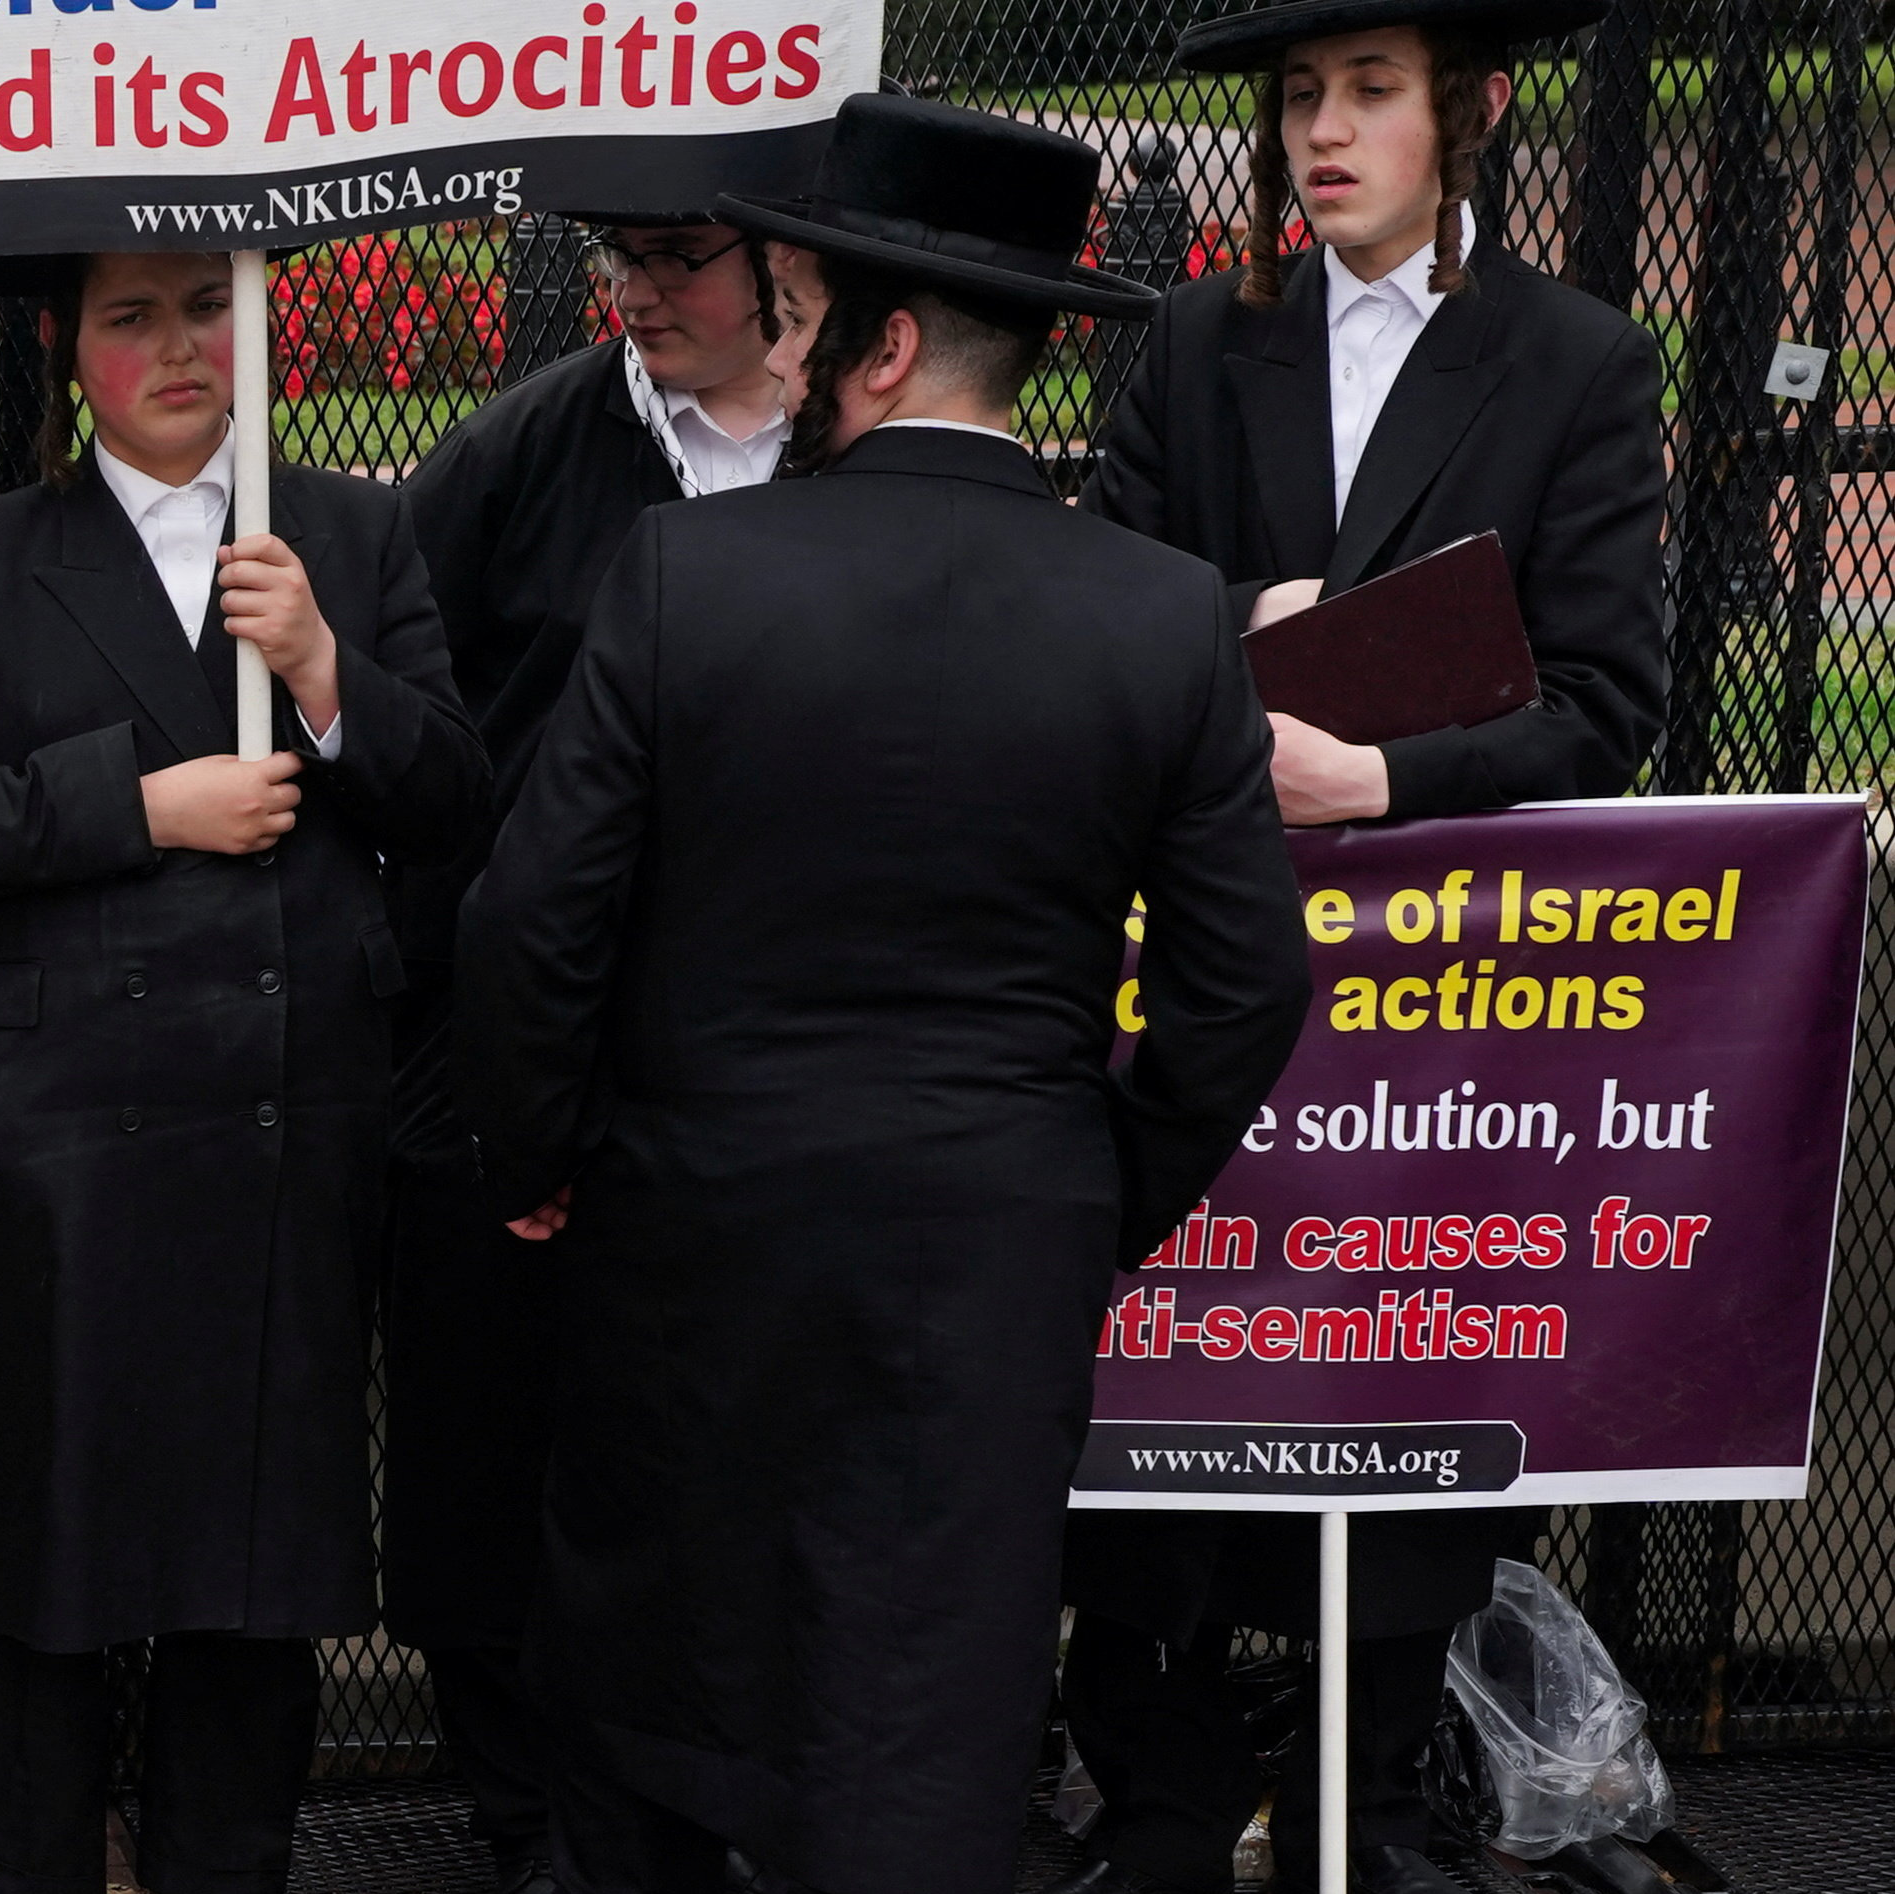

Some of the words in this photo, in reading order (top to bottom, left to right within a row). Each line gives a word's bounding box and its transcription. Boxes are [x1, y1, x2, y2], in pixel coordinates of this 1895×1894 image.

[94, 42, 228, 150] its
[263, 2, 823, 144] Atrocities
[126, 167, 524, 235] www.NKUSA.org
[1385, 870, 1474, 944] of
[1499, 869, 1742, 944] Israel
[1330, 960, 1645, 1032] actions
[1296, 1080, 1577, 1164] solution,
[1597, 1078, 1714, 1152] but
[1283, 1211, 1567, 1272] causes
[1591, 1196, 1711, 1270] for
[1128, 1439, 1461, 1485] www.NKUSA.org
